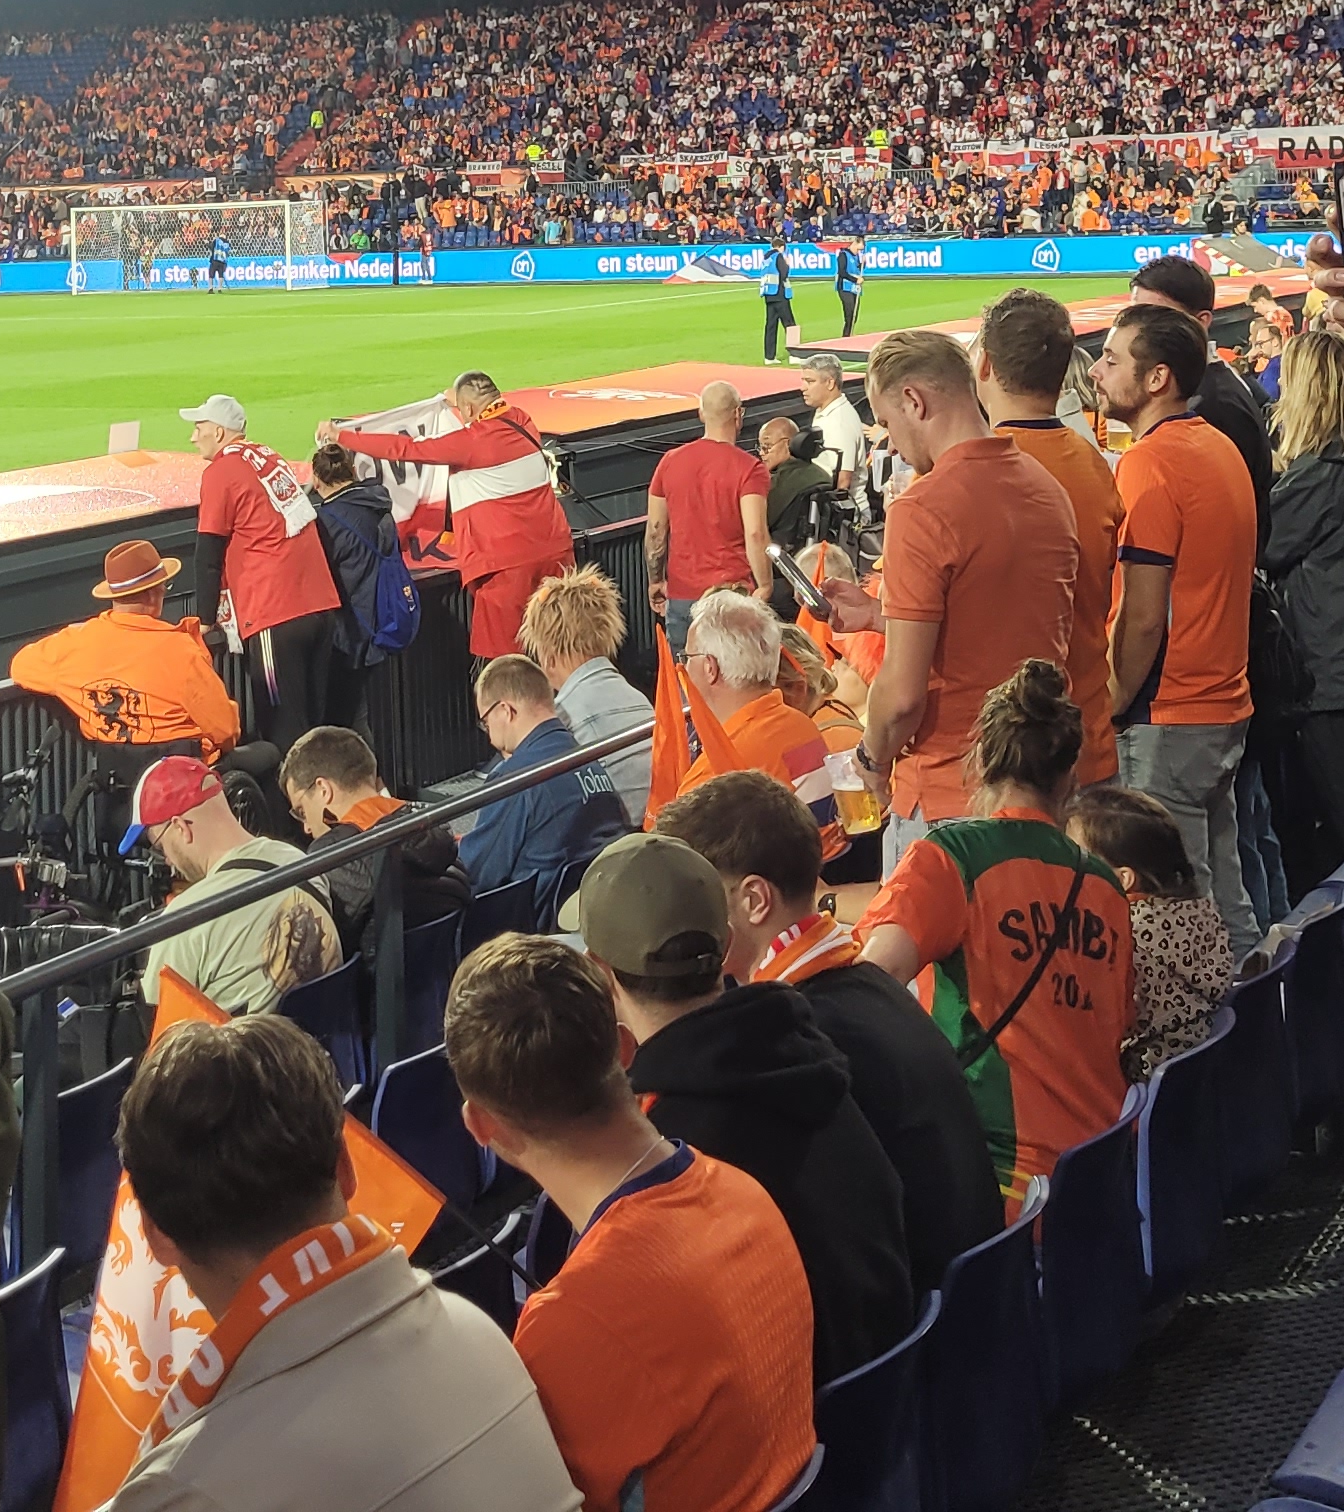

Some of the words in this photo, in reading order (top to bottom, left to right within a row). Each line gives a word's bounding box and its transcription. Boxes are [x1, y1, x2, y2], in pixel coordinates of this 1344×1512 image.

[225, 259, 340, 281] oedselbanken
[597, 257, 621, 273] en
[625, 252, 679, 272] steun
[574, 767, 614, 805] John
